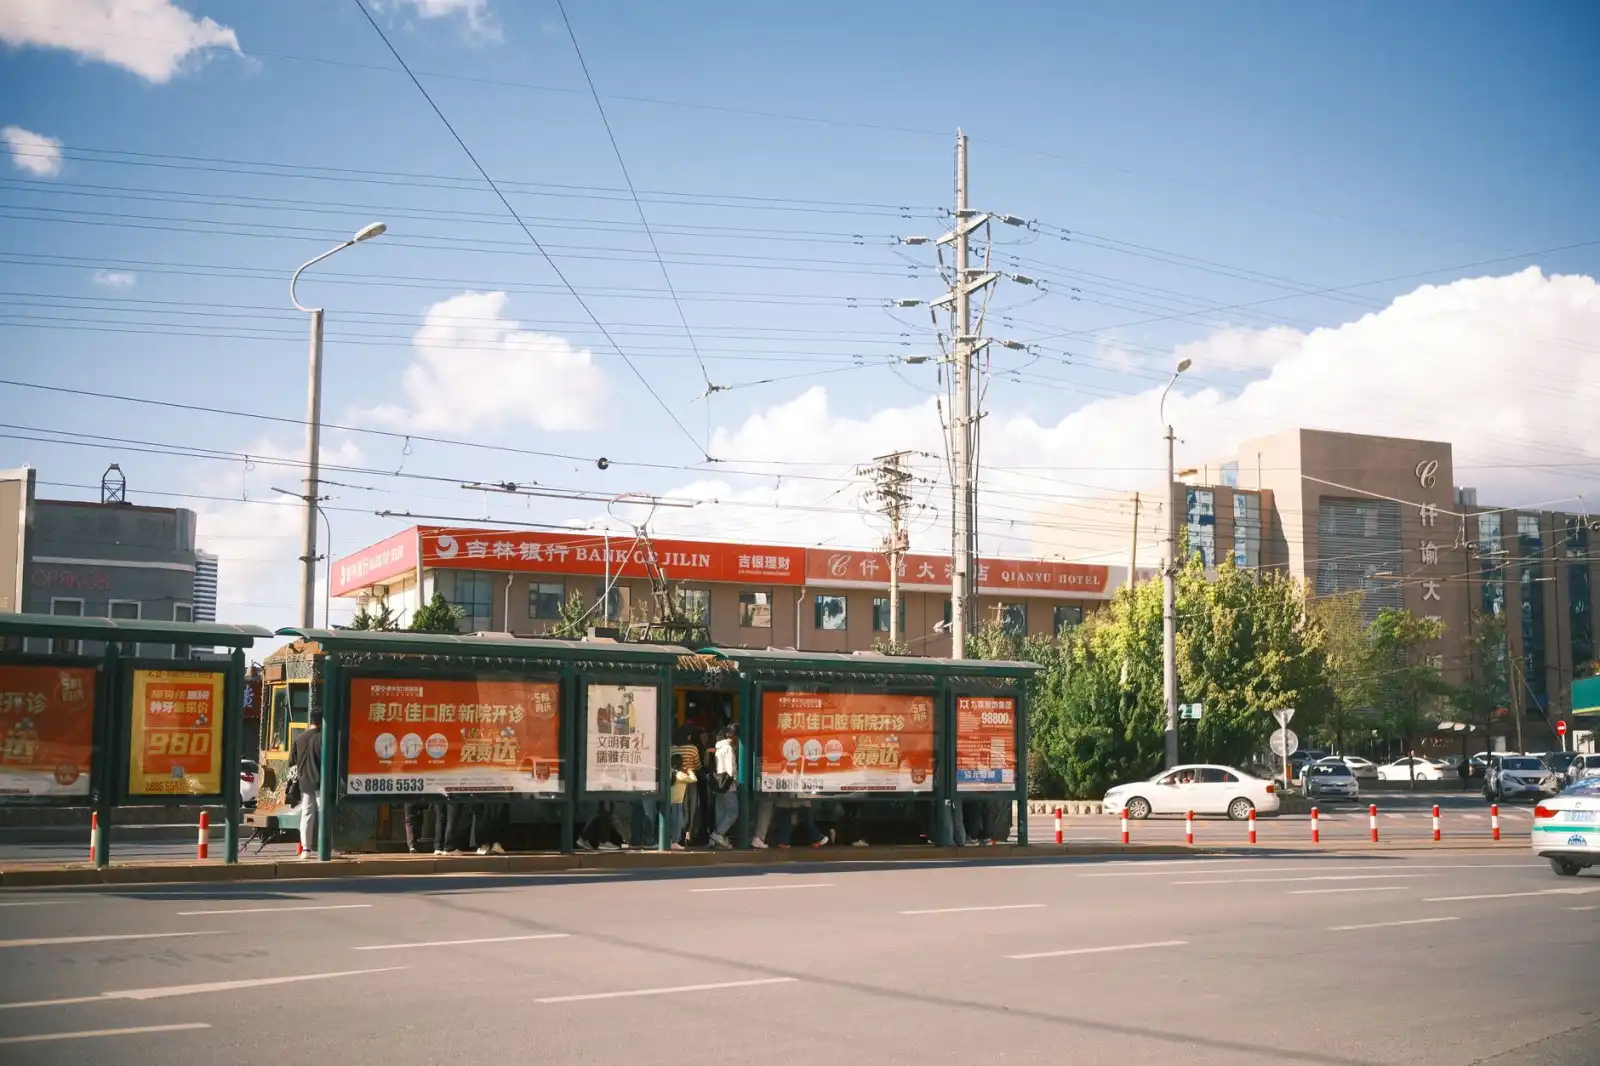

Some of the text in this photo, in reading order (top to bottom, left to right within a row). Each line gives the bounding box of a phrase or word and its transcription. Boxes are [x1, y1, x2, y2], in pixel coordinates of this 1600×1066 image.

[466, 539, 570, 563] 吉林银行
[576, 549, 628, 563] BANK
[662, 552, 711, 568] JILIN
[738, 554, 790, 570] 吉银理财
[860, 559, 990, 582] 仟大店
[1001, 571, 1100, 585] QIANYU HOTEL
[0, 692, 47, 715] 开诊
[981, 712, 1009, 724] 98800
[148, 732, 210, 755] 980
[596, 730, 649, 750] 文明有礼
[596, 749, 641, 764] 儒雅有你
[364, 778, 393, 792] 8886
[395, 778, 424, 792] 5533
